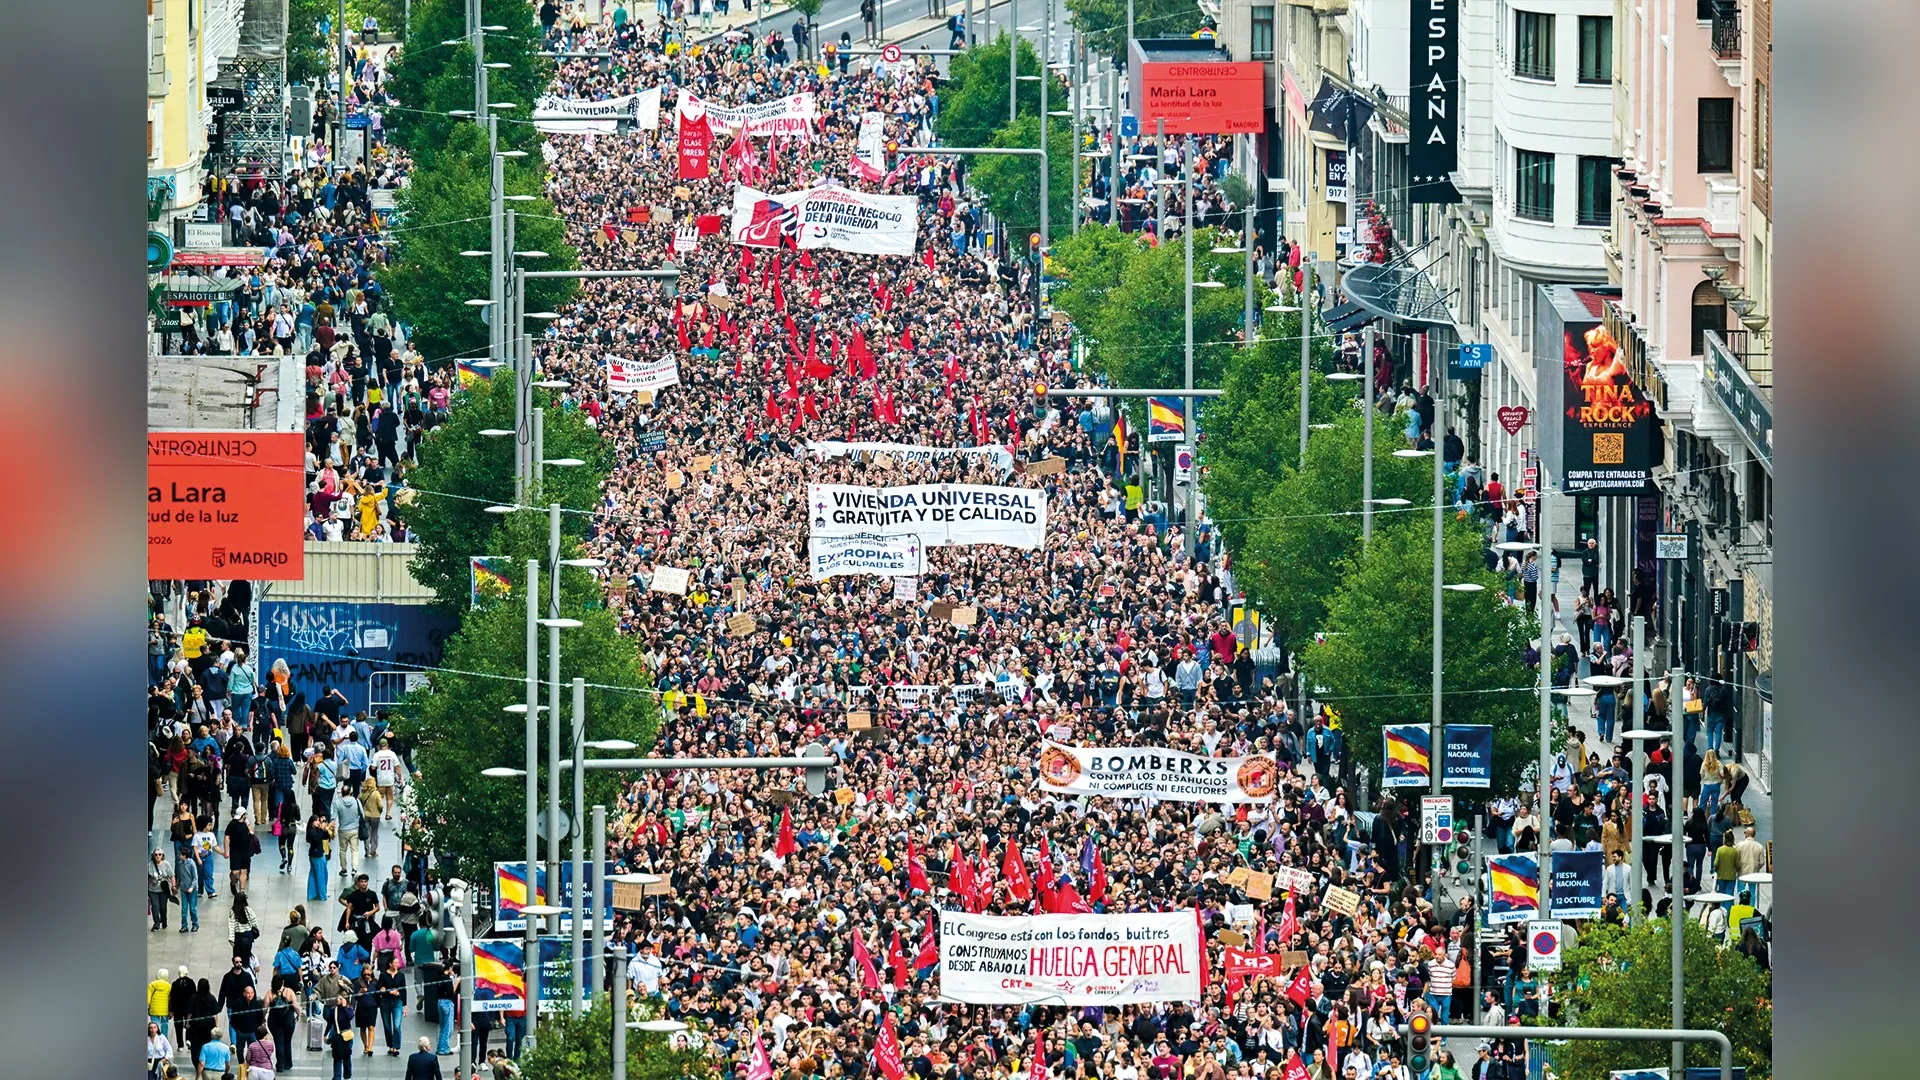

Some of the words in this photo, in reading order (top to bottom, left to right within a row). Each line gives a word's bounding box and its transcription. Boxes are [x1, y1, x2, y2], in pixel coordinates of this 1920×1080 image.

[1150, 86, 1186, 97] María
[1190, 87, 1217, 97] Lara
[548, 100, 559, 111] DE
[562, 101, 573, 113] LA
[573, 105, 617, 116] VIVIENDA
[1160, 100, 1190, 108] lentitud
[1192, 100, 1202, 108] de
[1232, 121, 1260, 129] MADRID
[683, 139, 702, 147] CLASE
[682, 149, 706, 157] OBRERA
[1329, 172, 1341, 181] EN
[1328, 188, 1342, 197] 917
[805, 200, 844, 214] CONTRA
[846, 204, 857, 216] EL
[859, 205, 902, 223] NEGOCIO
[804, 212, 819, 222] DE
[819, 212, 833, 223] LA
[834, 212, 879, 230] VIVIENDA
[167, 292, 219, 300] ESPAHOTEL
[1463, 359, 1481, 367] ATM
[626, 375, 657, 384] PÚBLICA
[1580, 384, 1635, 403] TINA
[1579, 405, 1636, 423] ROCK
[906, 450, 930, 463] POR
[1568, 470, 1592, 479] COMPRA
[1593, 470, 1605, 479] TUS
[1606, 470, 1636, 478] ENTRADAS
[1637, 470, 1646, 478] EN
[1568, 480, 1645, 488] WWW.CAPITOLGRANVIA.COM
[171, 481, 226, 503] Lara
[832, 491, 918, 510] VIVIENDA
[922, 490, 1035, 510] UNIVERSAL
[175, 509, 194, 523] de
[199, 509, 211, 523] la
[216, 509, 239, 523] luz
[832, 509, 913, 528] GRATUITA
[915, 508, 927, 522] Y
[932, 508, 955, 522] DE
[959, 507, 1036, 524] CALIDAD
[229, 552, 288, 567] MADRID
[817, 548, 904, 565] EXPROPIAR
[826, 560, 841, 571] LOS
[842, 559, 905, 569] CULPABLES
[380, 759, 391, 770] 21
[1091, 755, 1228, 775] BOMBERXS
[1455, 767, 1485, 776] OCTUBRE
[1089, 772, 1132, 781] CONTRA
[1137, 772, 1156, 781] LOS
[1161, 774, 1228, 786] DESAHUCIOS
[1156, 783, 1167, 792] NI
[1171, 784, 1227, 796] EJECUTORES
[1556, 871, 1577, 879] FIESTA
[1564, 896, 1595, 905] OCTUBRE
[943, 922, 955, 936] El
[957, 922, 1007, 942] Congreso
[1011, 928, 1033, 942] está
[1034, 930, 1053, 941] con
[1057, 927, 1076, 941] los
[1078, 927, 1120, 942] fondos
[1126, 926, 1170, 941] buitres
[948, 944, 1028, 961] CONSTRUYAMOS
[1029, 946, 1099, 977] HUELGA
[1103, 943, 1190, 977] GENERAL
[948, 960, 976, 972] DESDE
[979, 961, 1011, 974] ABAJO
[1014, 963, 1026, 975] LA
[1001, 979, 1023, 989] CRT
[489, 1002, 513, 1010] MADRID
